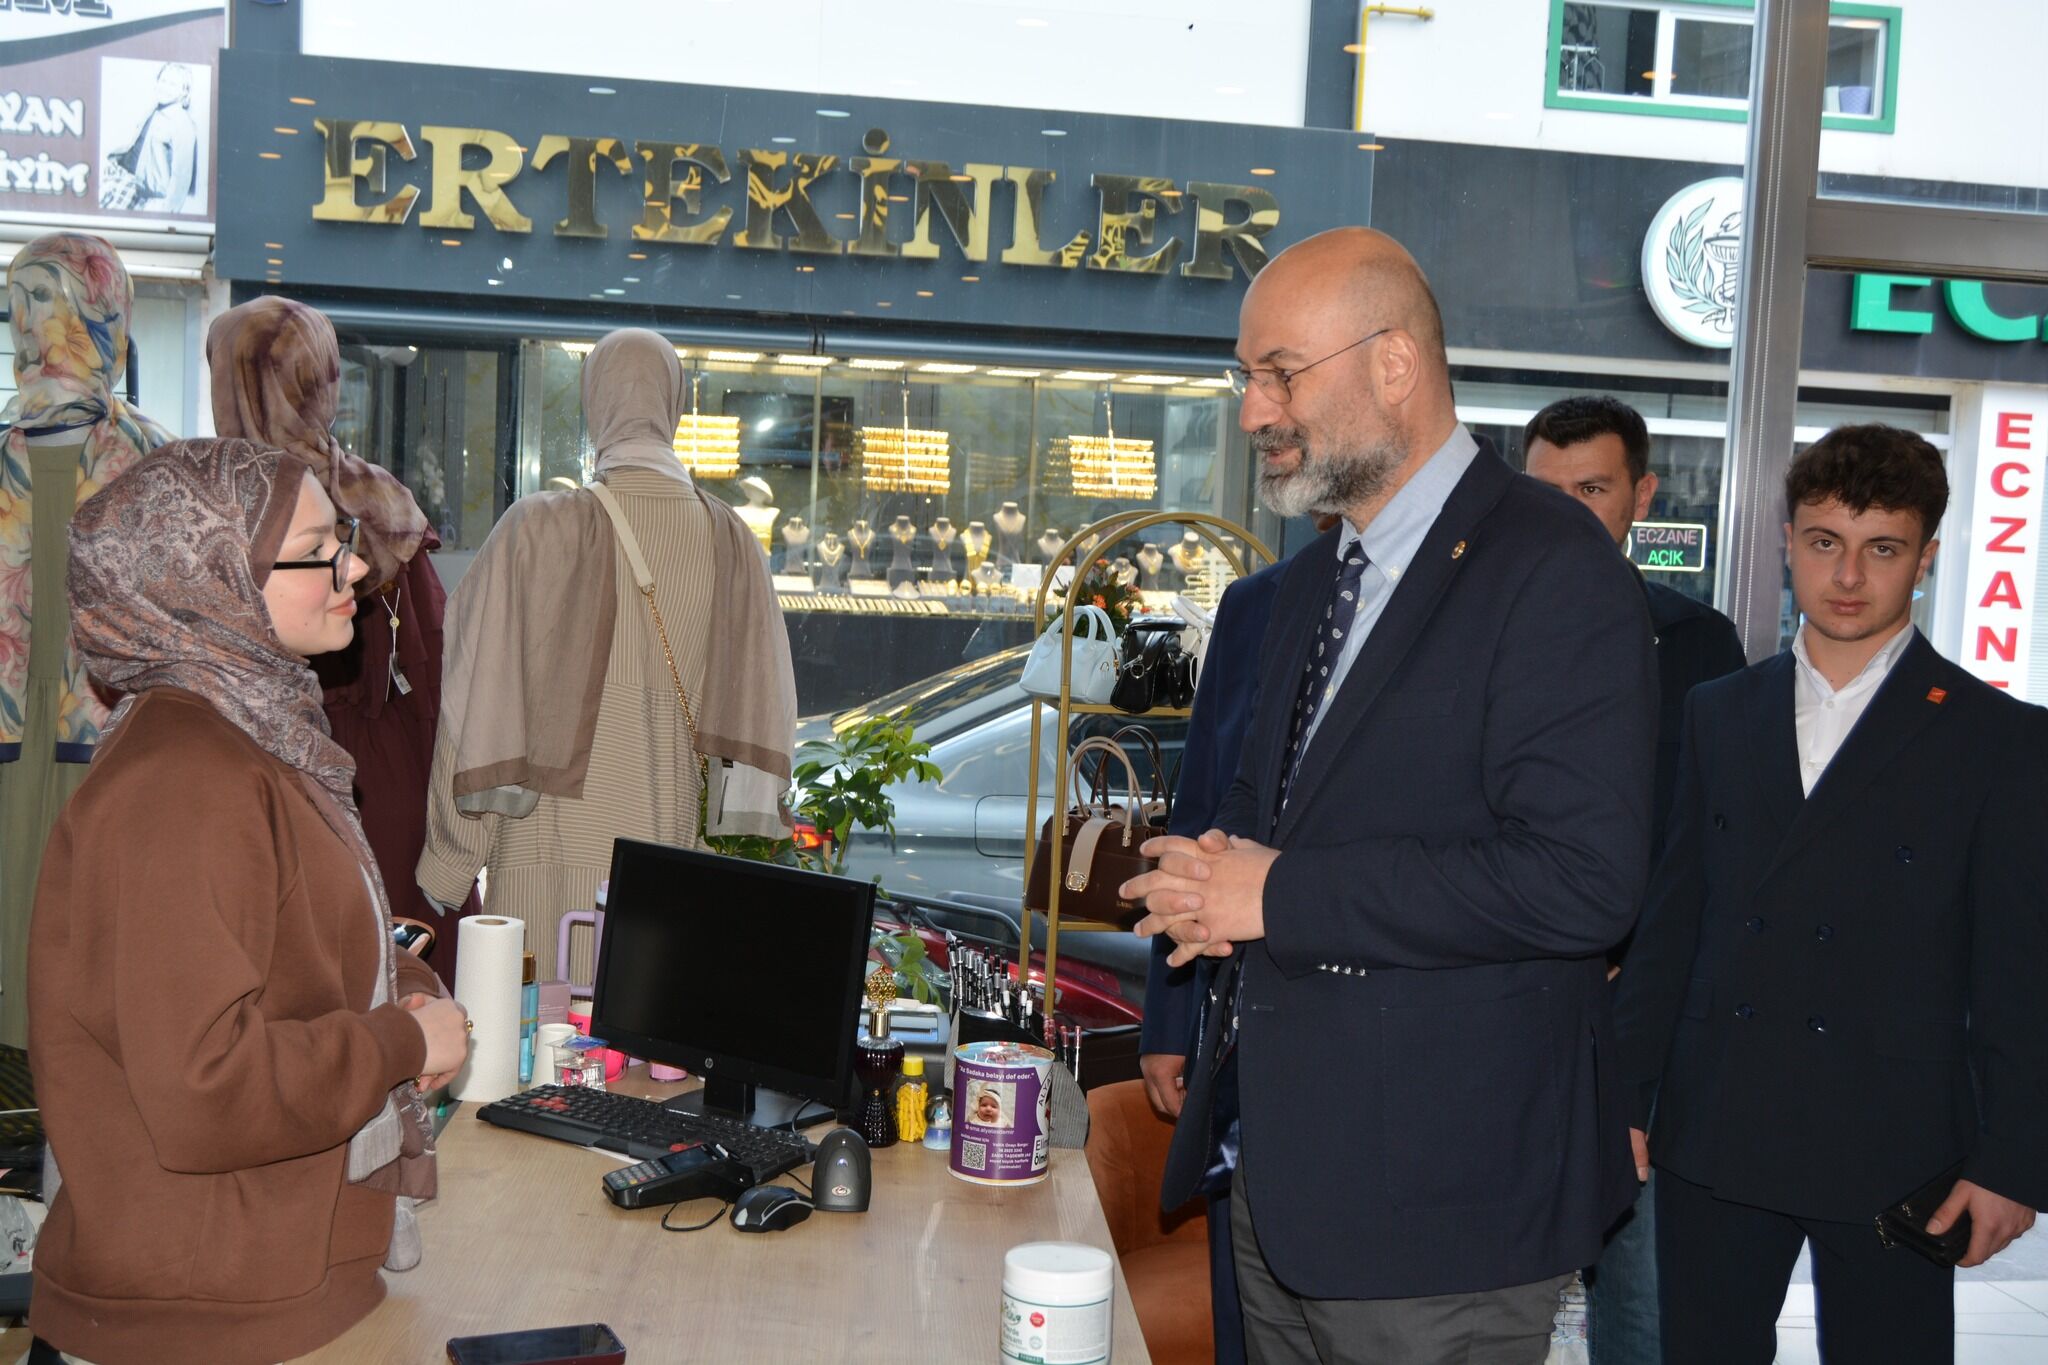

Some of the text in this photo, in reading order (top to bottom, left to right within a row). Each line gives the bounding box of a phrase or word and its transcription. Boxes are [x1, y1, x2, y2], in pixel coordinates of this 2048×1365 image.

[312, 118, 1280, 282] ERTEKİNLER
[1850, 273, 2048, 342] EC
[1636, 527, 1698, 545] ECZANE
[1647, 549, 1684, 567] AÇIK
[1975, 411, 2034, 689] ECZAN
